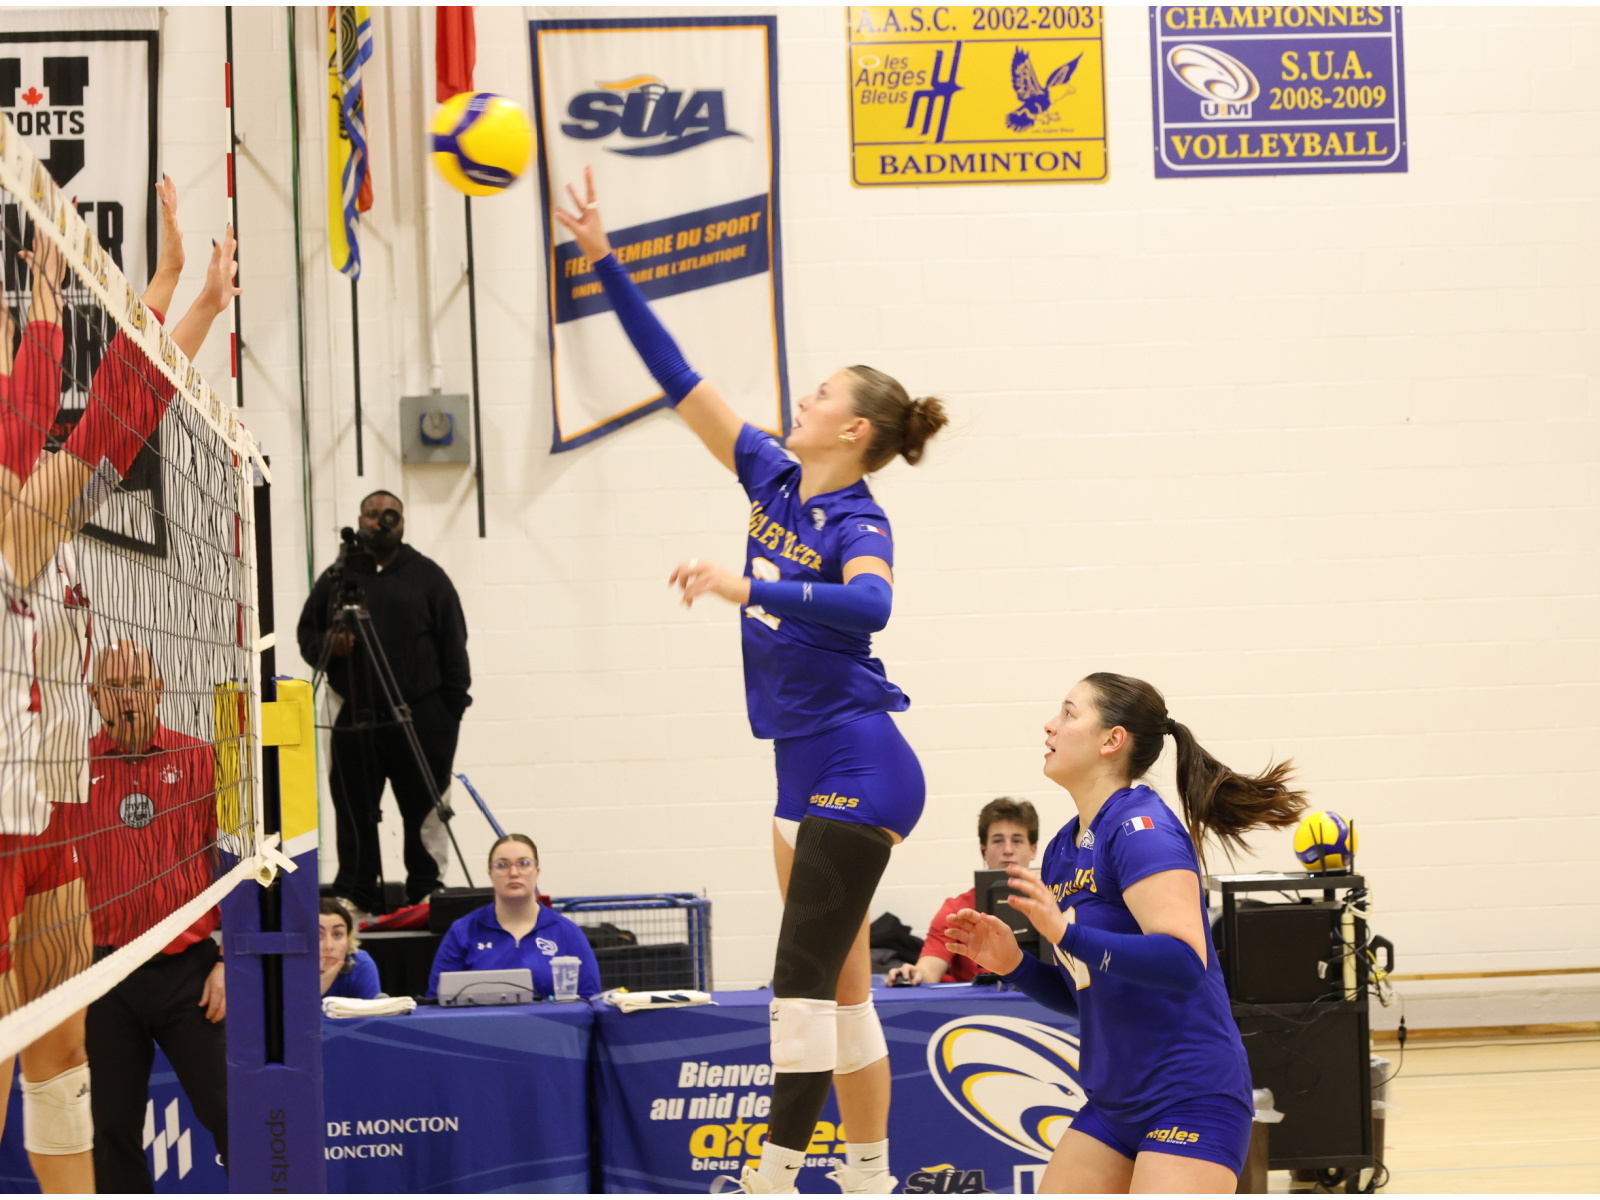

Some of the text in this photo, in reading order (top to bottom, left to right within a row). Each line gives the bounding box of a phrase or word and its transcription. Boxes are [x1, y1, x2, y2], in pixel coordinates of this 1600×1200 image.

[855, 6, 1094, 33] A.A.S.C. 2002-2003
[1165, 6, 1384, 30] CHAMPIONNES
[884, 55, 908, 70] les
[1281, 50, 1372, 81] S.U.A.
[856, 68, 926, 89] Anges
[861, 89, 908, 105] Bleus
[1269, 85, 1387, 110] 2008-2009
[5, 110, 85, 136] ORTS
[1170, 131, 1388, 160] VOLLEYBALL
[879, 151, 1082, 175] BADMINTON
[612, 235, 674, 265] EMBRE
[676, 227, 702, 251] DU
[704, 212, 761, 243] SPORT
[650, 1098, 685, 1120] au
[688, 1092, 735, 1120] nid
[327, 1116, 459, 1137] DE MONCTON
[266, 1108, 290, 1183] sports
[691, 1158, 740, 1171] bleus
